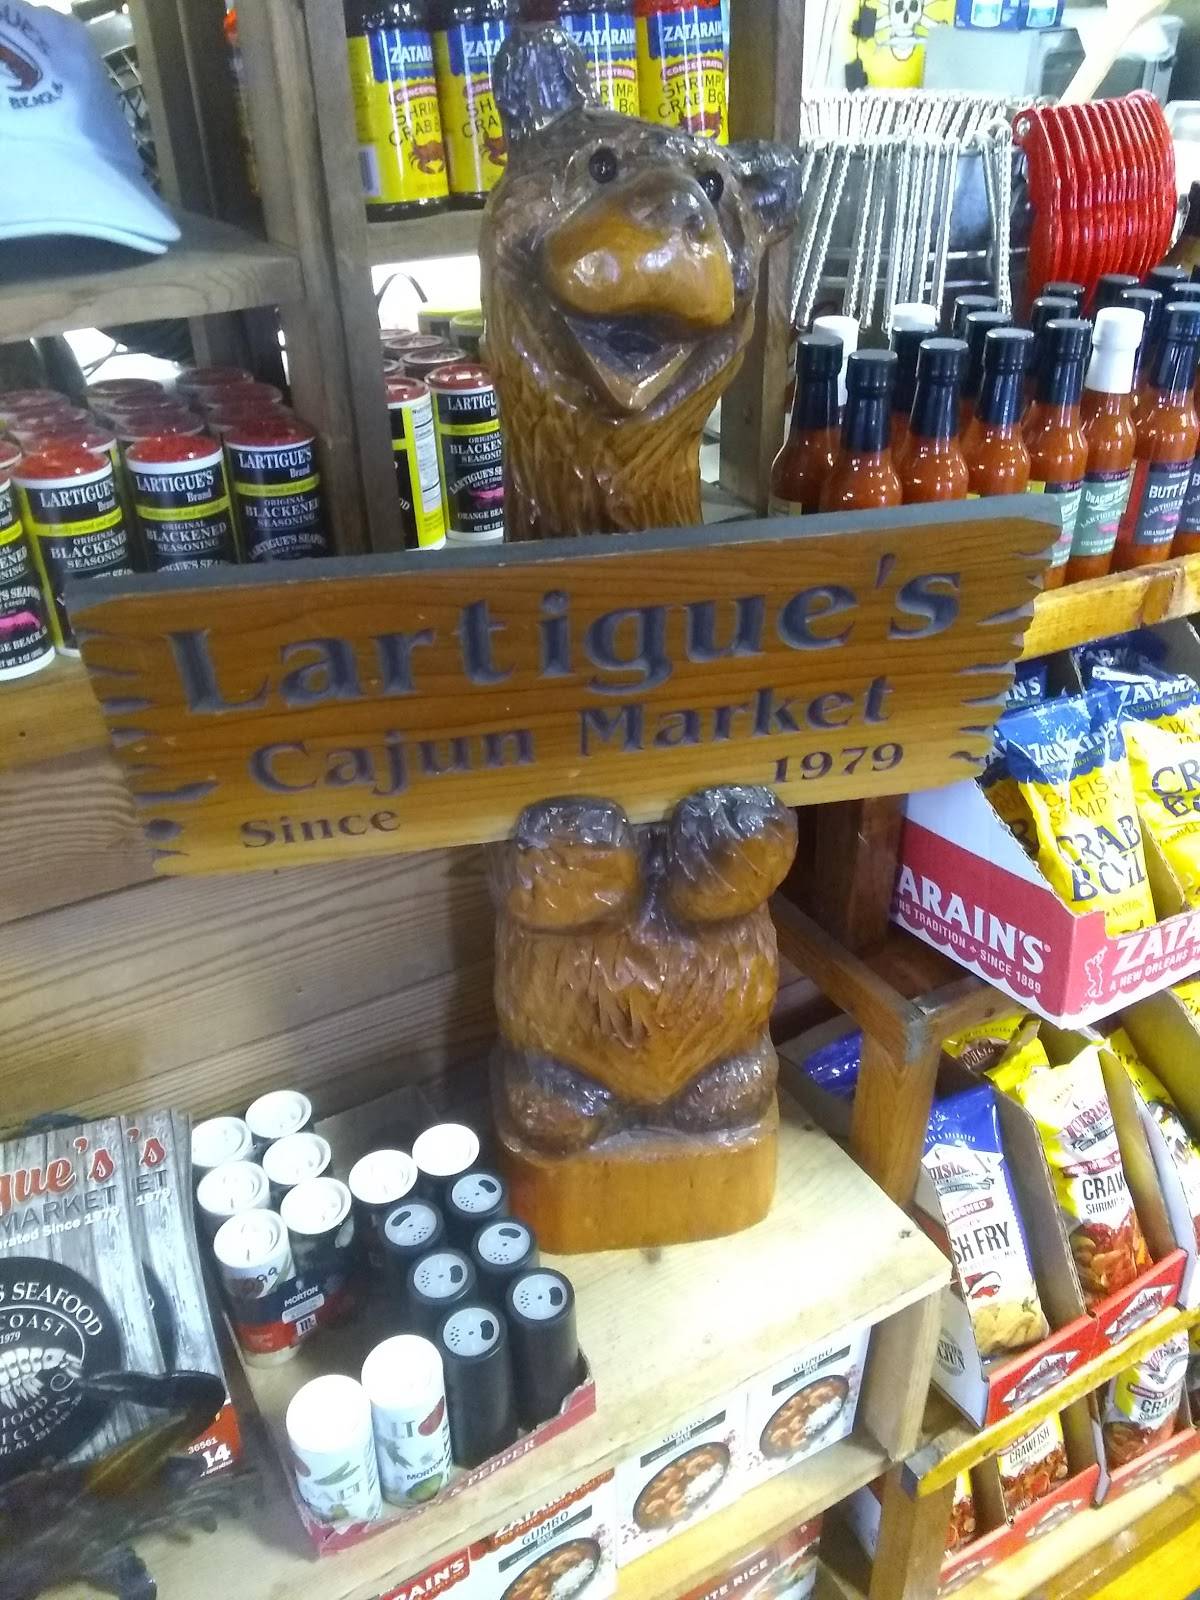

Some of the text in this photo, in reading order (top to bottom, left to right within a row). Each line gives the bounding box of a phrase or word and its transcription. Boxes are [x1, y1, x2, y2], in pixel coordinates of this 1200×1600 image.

[135, 469, 214, 494] LARTIGUE'S
[186, 488, 213, 504] Brand
[263, 495, 305, 507] ORIGINAL
[145, 520, 228, 544] BLACKENED
[161, 519, 205, 532] ORIGINAL
[157, 539, 220, 555] SEASONING
[164, 552, 961, 714] Lartigue's
[248, 675, 895, 796] Cajun Market
[241, 742, 904, 848] Since 1979
[914, 908, 967, 950] TRADITION
[980, 948, 1013, 978] SINCE
[1015, 970, 1042, 995] 1889
[1119, 968, 1143, 988] NEW
[1144, 948, 1190, 977] ORLEANS
[135, 1188, 172, 1207] 1979
[42, 1219, 81, 1237] Since
[84, 1206, 121, 1226] 1979
[973, 1221, 1010, 1256] FRY
[12, 1281, 103, 1336] SEAFOOD
[283, 1284, 320, 1308] MORTON
[521, 1510, 569, 1547] GUMBO
[733, 1558, 769, 1588] RICE
